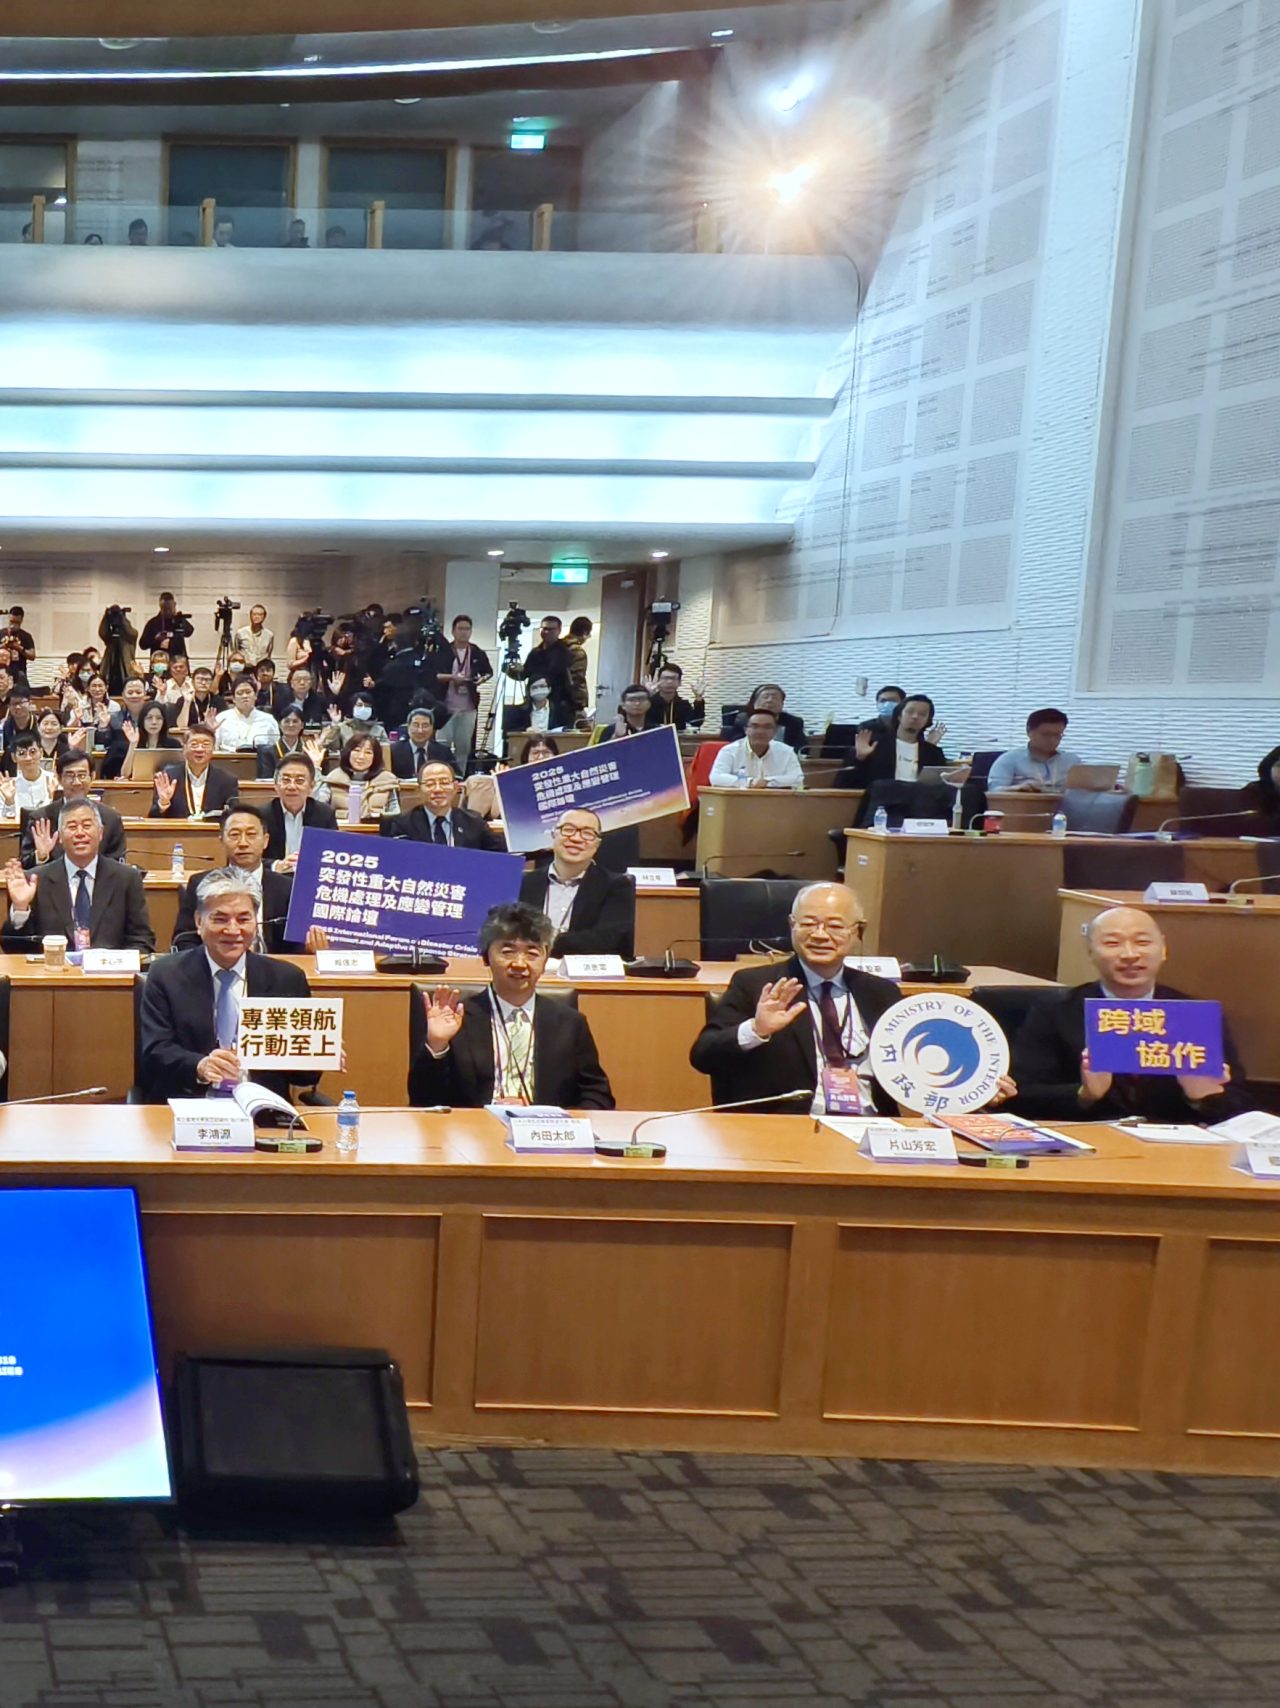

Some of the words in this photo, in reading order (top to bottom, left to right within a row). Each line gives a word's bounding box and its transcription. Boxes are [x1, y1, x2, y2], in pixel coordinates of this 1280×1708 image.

[321, 850, 379, 869] 2025
[318, 867, 466, 901] 突發性重大自然災害
[312, 903, 379, 926] 國際論壇
[315, 886, 464, 919] 危機處理及應變管理
[241, 1008, 336, 1031] 專業領航
[884, 1000, 944, 1034] MINISTRY
[954, 1004, 974, 1018] OF
[1098, 1008, 1166, 1035] 跨域
[977, 1018, 999, 1044] THE
[240, 1034, 336, 1057] 行動至上
[1136, 1040, 1207, 1069] 協作
[958, 1052, 1001, 1106] INTERIOR
[198, 1129, 231, 1139] 李鴻源
[890, 1140, 936, 1151] 片山芳宏
